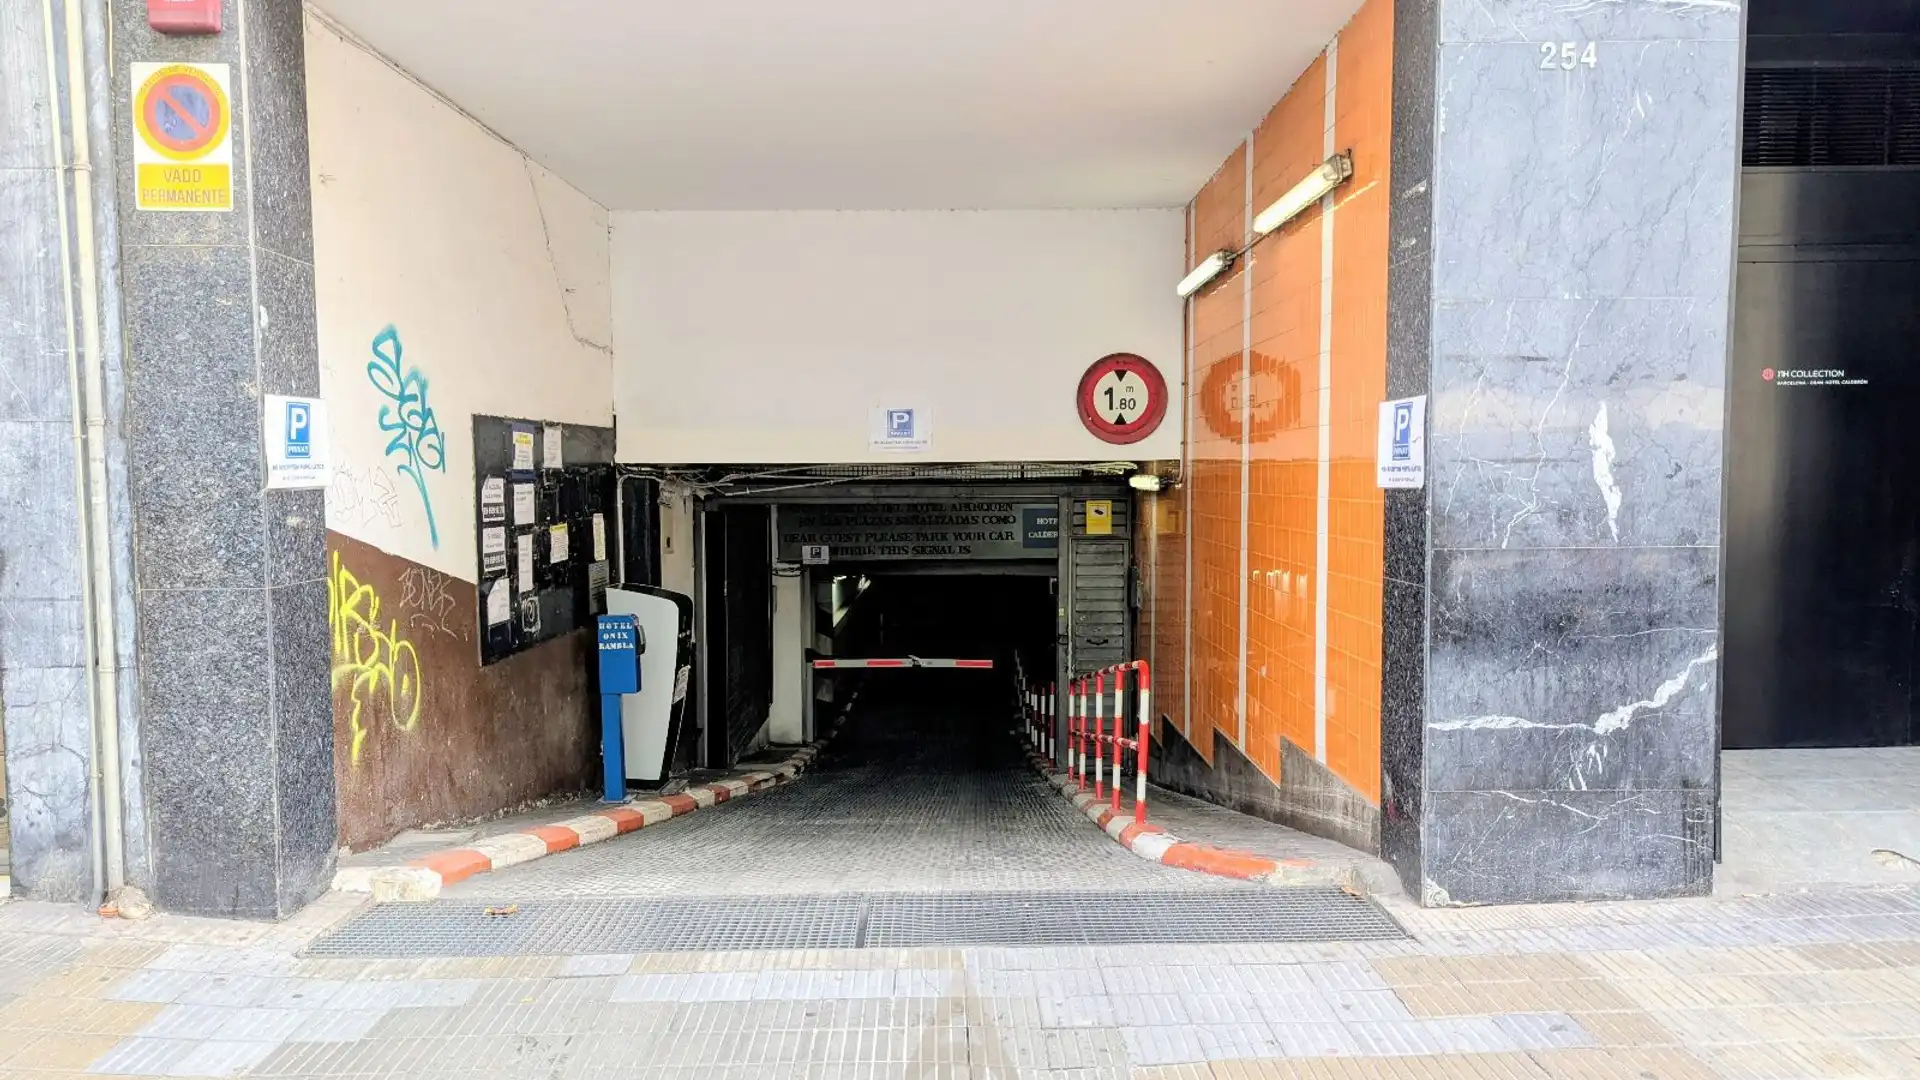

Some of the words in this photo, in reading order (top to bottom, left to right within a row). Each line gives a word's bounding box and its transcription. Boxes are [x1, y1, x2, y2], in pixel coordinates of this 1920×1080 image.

[1540, 41, 1598, 70] 254
[164, 169, 201, 183] VADO
[142, 189, 225, 203] PERMANENTE
[1791, 369, 1845, 378] COLLECTION
[290, 407, 307, 439] P
[892, 412, 909, 429] P
[1396, 408, 1409, 440] P
[845, 516, 892, 525] PLAZAS
[982, 515, 1016, 525] COMO
[820, 533, 862, 542] GUEST
[865, 533, 912, 542] PLEASE
[916, 532, 948, 541] PARK
[953, 532, 986, 541] YOUR
[989, 531, 1015, 541] CAR
[878, 546, 908, 555] THIS
[911, 546, 956, 555] SIGNAL
[958, 545, 971, 554] IS
[598, 622, 633, 630] HOTEL
[603, 632, 628, 640] ONIX
[598, 642, 635, 650] RAMBLA
